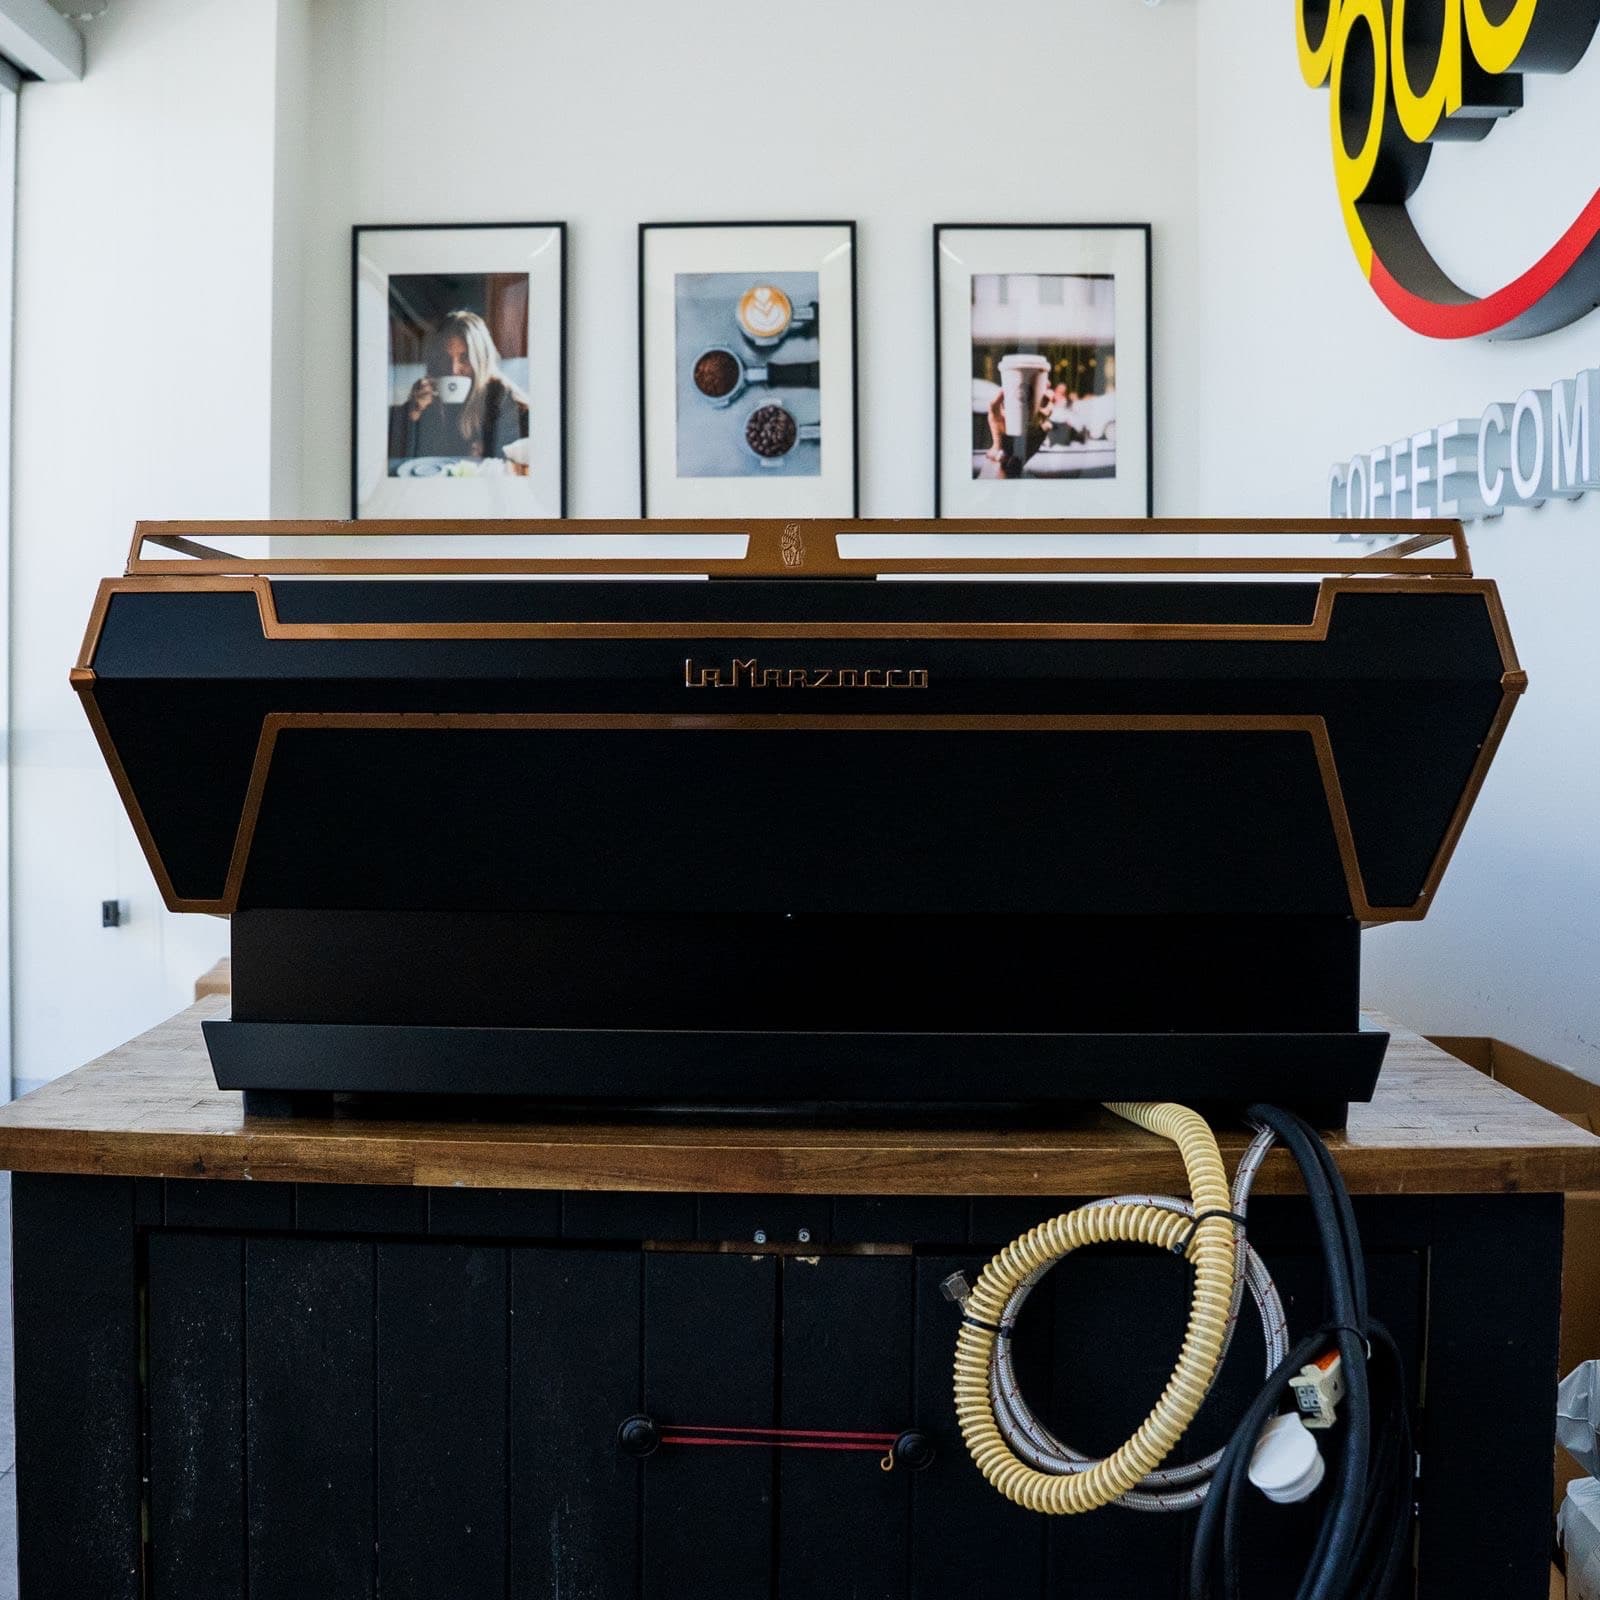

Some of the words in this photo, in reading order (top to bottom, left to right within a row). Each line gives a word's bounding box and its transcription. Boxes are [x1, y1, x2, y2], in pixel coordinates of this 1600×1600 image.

[1328, 418, 1460, 542] COFFEE
[685, 658, 721, 688] La
[732, 658, 929, 688] Marzocco
